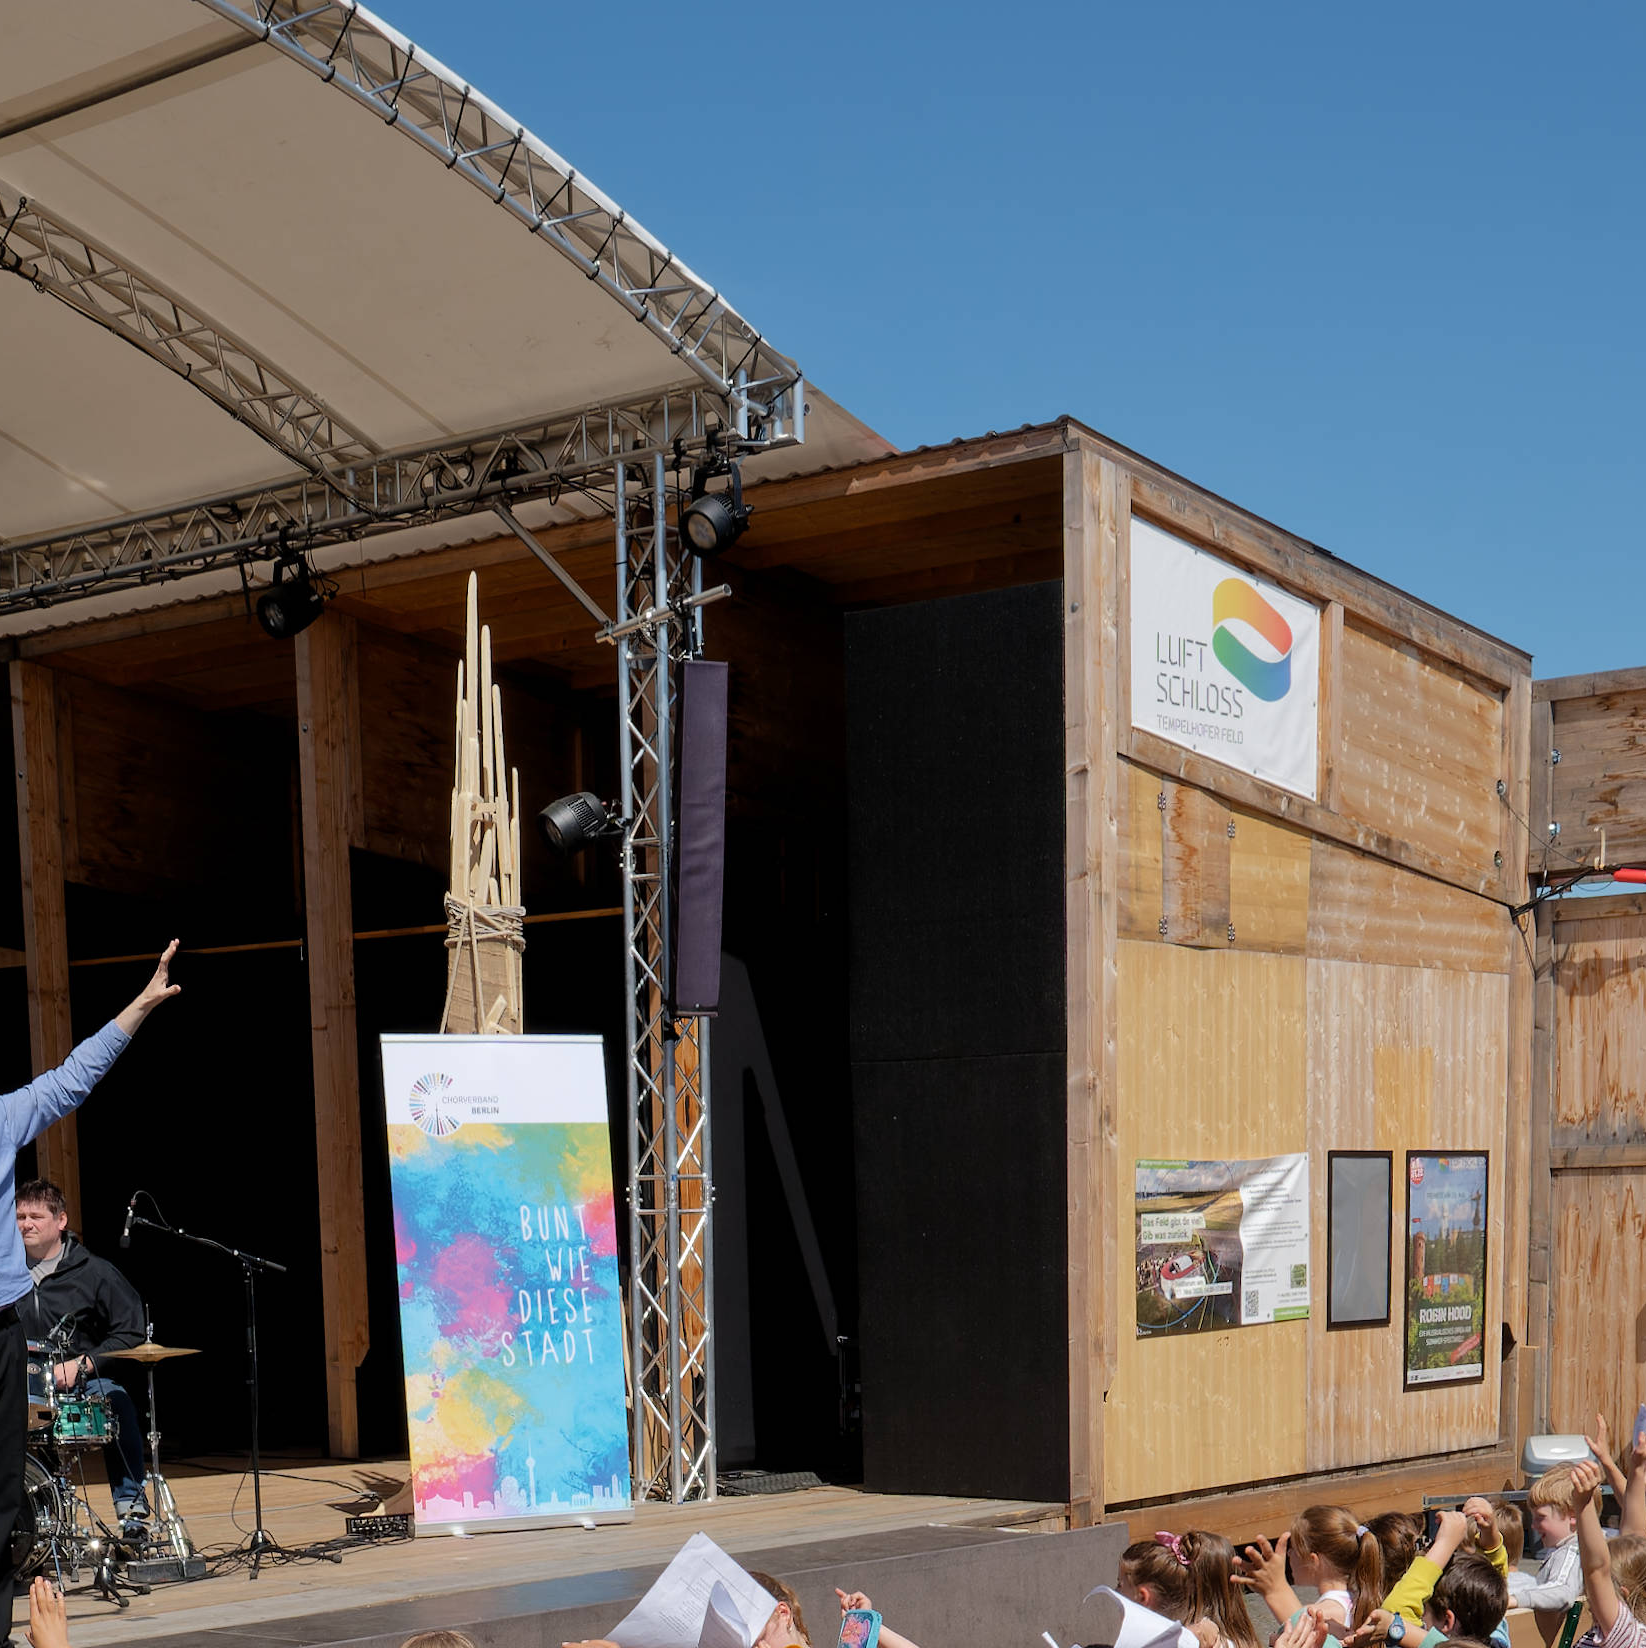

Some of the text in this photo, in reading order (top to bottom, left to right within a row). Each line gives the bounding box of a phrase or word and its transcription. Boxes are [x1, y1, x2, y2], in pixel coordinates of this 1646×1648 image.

[1156, 631, 1208, 673] LUFT
[1156, 672, 1243, 719] SCHLOSS
[1156, 713, 1244, 745] TEMPELHOFER FELD
[441, 1094, 500, 1105] CHORVERBAND
[470, 1106, 500, 1115] BERLIN
[519, 1203, 589, 1242] BUNT
[546, 1244, 592, 1283] WIE
[519, 1287, 593, 1326] DIESE
[1419, 1305, 1472, 1324] ROBIN HOOD
[502, 1329, 595, 1368] STADT
